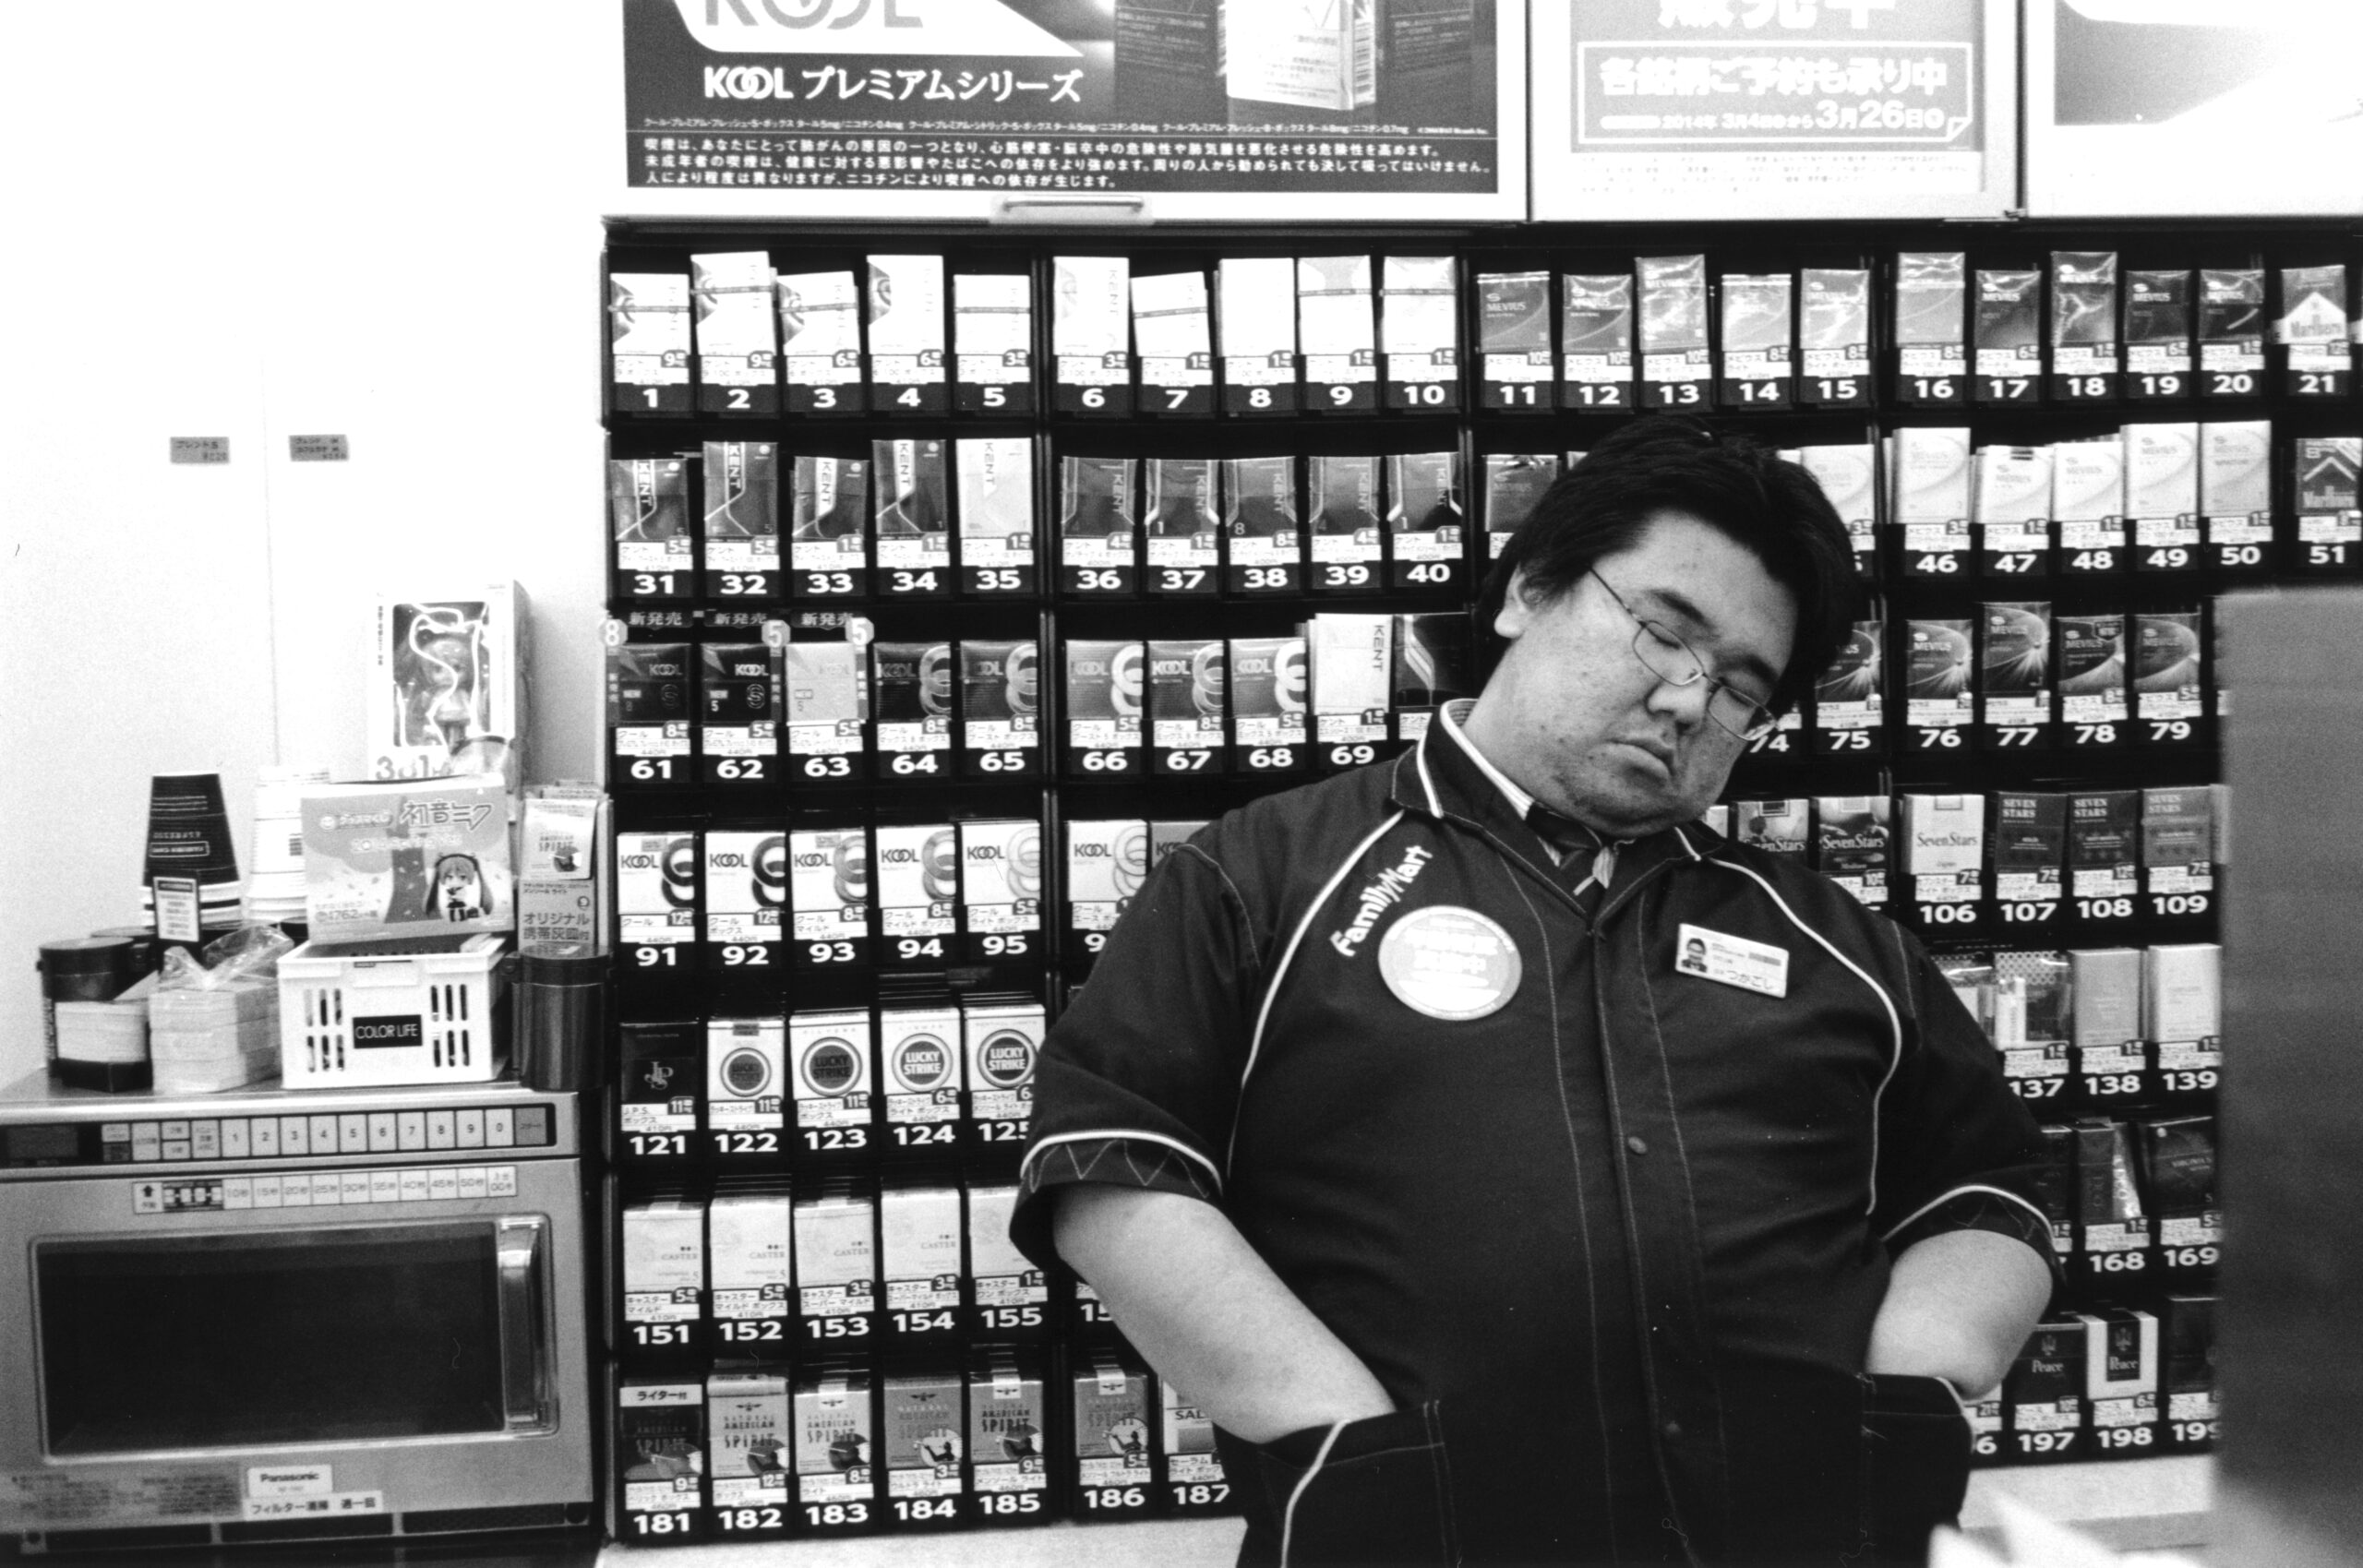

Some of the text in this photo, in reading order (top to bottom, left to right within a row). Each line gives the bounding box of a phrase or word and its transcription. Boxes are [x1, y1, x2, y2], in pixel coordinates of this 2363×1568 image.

[704, 66, 1085, 102] KOOL プレミアムシリーズ
[1486, 301, 1527, 312] MEVIUS
[1659, 383, 1700, 404] 13
[1738, 381, 1781, 402] 14
[1817, 378, 1858, 400] 15
[1913, 378, 1954, 400] 16
[1989, 378, 2030, 399] 17
[2067, 376, 2106, 397] 18
[2141, 375, 2181, 395] 19
[2212, 373, 2253, 394] 20
[2298, 373, 2335, 394] 21
[642, 387, 659, 409] 1
[726, 388, 751, 410] 2
[812, 387, 837, 409] 3
[896, 387, 922, 408] 4
[982, 386, 1007, 408] 5
[1081, 387, 1106, 409] 6
[1165, 389, 1189, 410] 7
[1248, 388, 1273, 409] 8
[1328, 385, 1353, 406] 9
[1403, 384, 1446, 405] 10
[1499, 385, 1536, 405] 11
[1577, 384, 1621, 406] 12
[1915, 553, 1959, 573] 46
[1994, 553, 2037, 573] 47
[2071, 550, 2114, 570] 48
[2146, 547, 2189, 568] 49
[2220, 545, 2261, 566] 50
[2309, 545, 2345, 565] 51
[807, 572, 854, 594] 33
[892, 570, 939, 592] 34
[976, 569, 1022, 591] 35
[1075, 569, 1122, 591] 36
[1160, 569, 1206, 591] 37
[1243, 567, 1289, 589] 38
[1325, 564, 1370, 586] 39
[1406, 563, 1451, 583] 40
[632, 573, 675, 595] 31
[720, 574, 768, 595] 32
[628, 611, 683, 627] 新発売
[735, 663, 770, 676] KOOL
[1829, 730, 1871, 750] 75
[1919, 728, 1961, 748] 76
[1997, 726, 2039, 747] 77
[2074, 724, 2117, 744] 78
[2149, 721, 2191, 741] 79
[892, 753, 939, 775] 64
[979, 750, 1026, 772] 65
[1082, 750, 1128, 772] 66
[1166, 749, 1212, 771] 67
[1249, 747, 1294, 769] 68
[1330, 745, 1375, 765] 69
[630, 759, 672, 780] 61
[716, 759, 764, 780] 62
[804, 756, 851, 778] 63
[397, 799, 494, 832] 初音ミク
[709, 853, 750, 868] KOOL
[794, 853, 832, 868] KOOL
[881, 848, 920, 864] KOOL
[966, 845, 1006, 860] KOOL
[1074, 843, 1113, 857] KOOL
[620, 854, 660, 869] KOOL
[1330, 844, 1433, 957] FamilyMart
[2077, 898, 2133, 919] 108
[2153, 894, 2209, 915] 109
[523, 912, 591, 926] オリジナル
[1919, 904, 1977, 924] 106
[2000, 902, 2057, 922] 107
[721, 945, 770, 966] 92
[809, 941, 856, 964] 93
[897, 938, 944, 959] 94
[981, 934, 1028, 956] 95
[635, 946, 677, 967] 91
[355, 1023, 419, 1040] COLOR LIFE
[905, 1050, 941, 1064] LUCKY
[990, 1045, 1025, 1059] LUCKY
[903, 1061, 942, 1076] STRIKE
[988, 1057, 1026, 1072] STRIKE
[2009, 1078, 2065, 1098] 137
[2085, 1074, 2141, 1095] 138
[2162, 1071, 2218, 1091] 139
[630, 1134, 686, 1155] 121
[714, 1132, 779, 1154] 122
[804, 1128, 868, 1151] 123
[893, 1124, 956, 1145] 124
[2089, 1251, 2145, 1273] 168
[2164, 1247, 2219, 1267] 169
[807, 1316, 870, 1339] 153
[893, 1311, 955, 1333] 154
[981, 1307, 1042, 1328] 155
[633, 1324, 690, 1345] 151
[719, 1320, 783, 1341] 152
[2018, 1431, 2075, 1453] 197
[2097, 1426, 2153, 1448] 198
[978, 1492, 1041, 1514] 185
[1084, 1487, 1146, 1509] 186
[1172, 1483, 1230, 1505] 187
[718, 1507, 783, 1530] 182
[805, 1502, 869, 1526] 183
[894, 1498, 957, 1521] 184
[633, 1512, 690, 1535] 181
